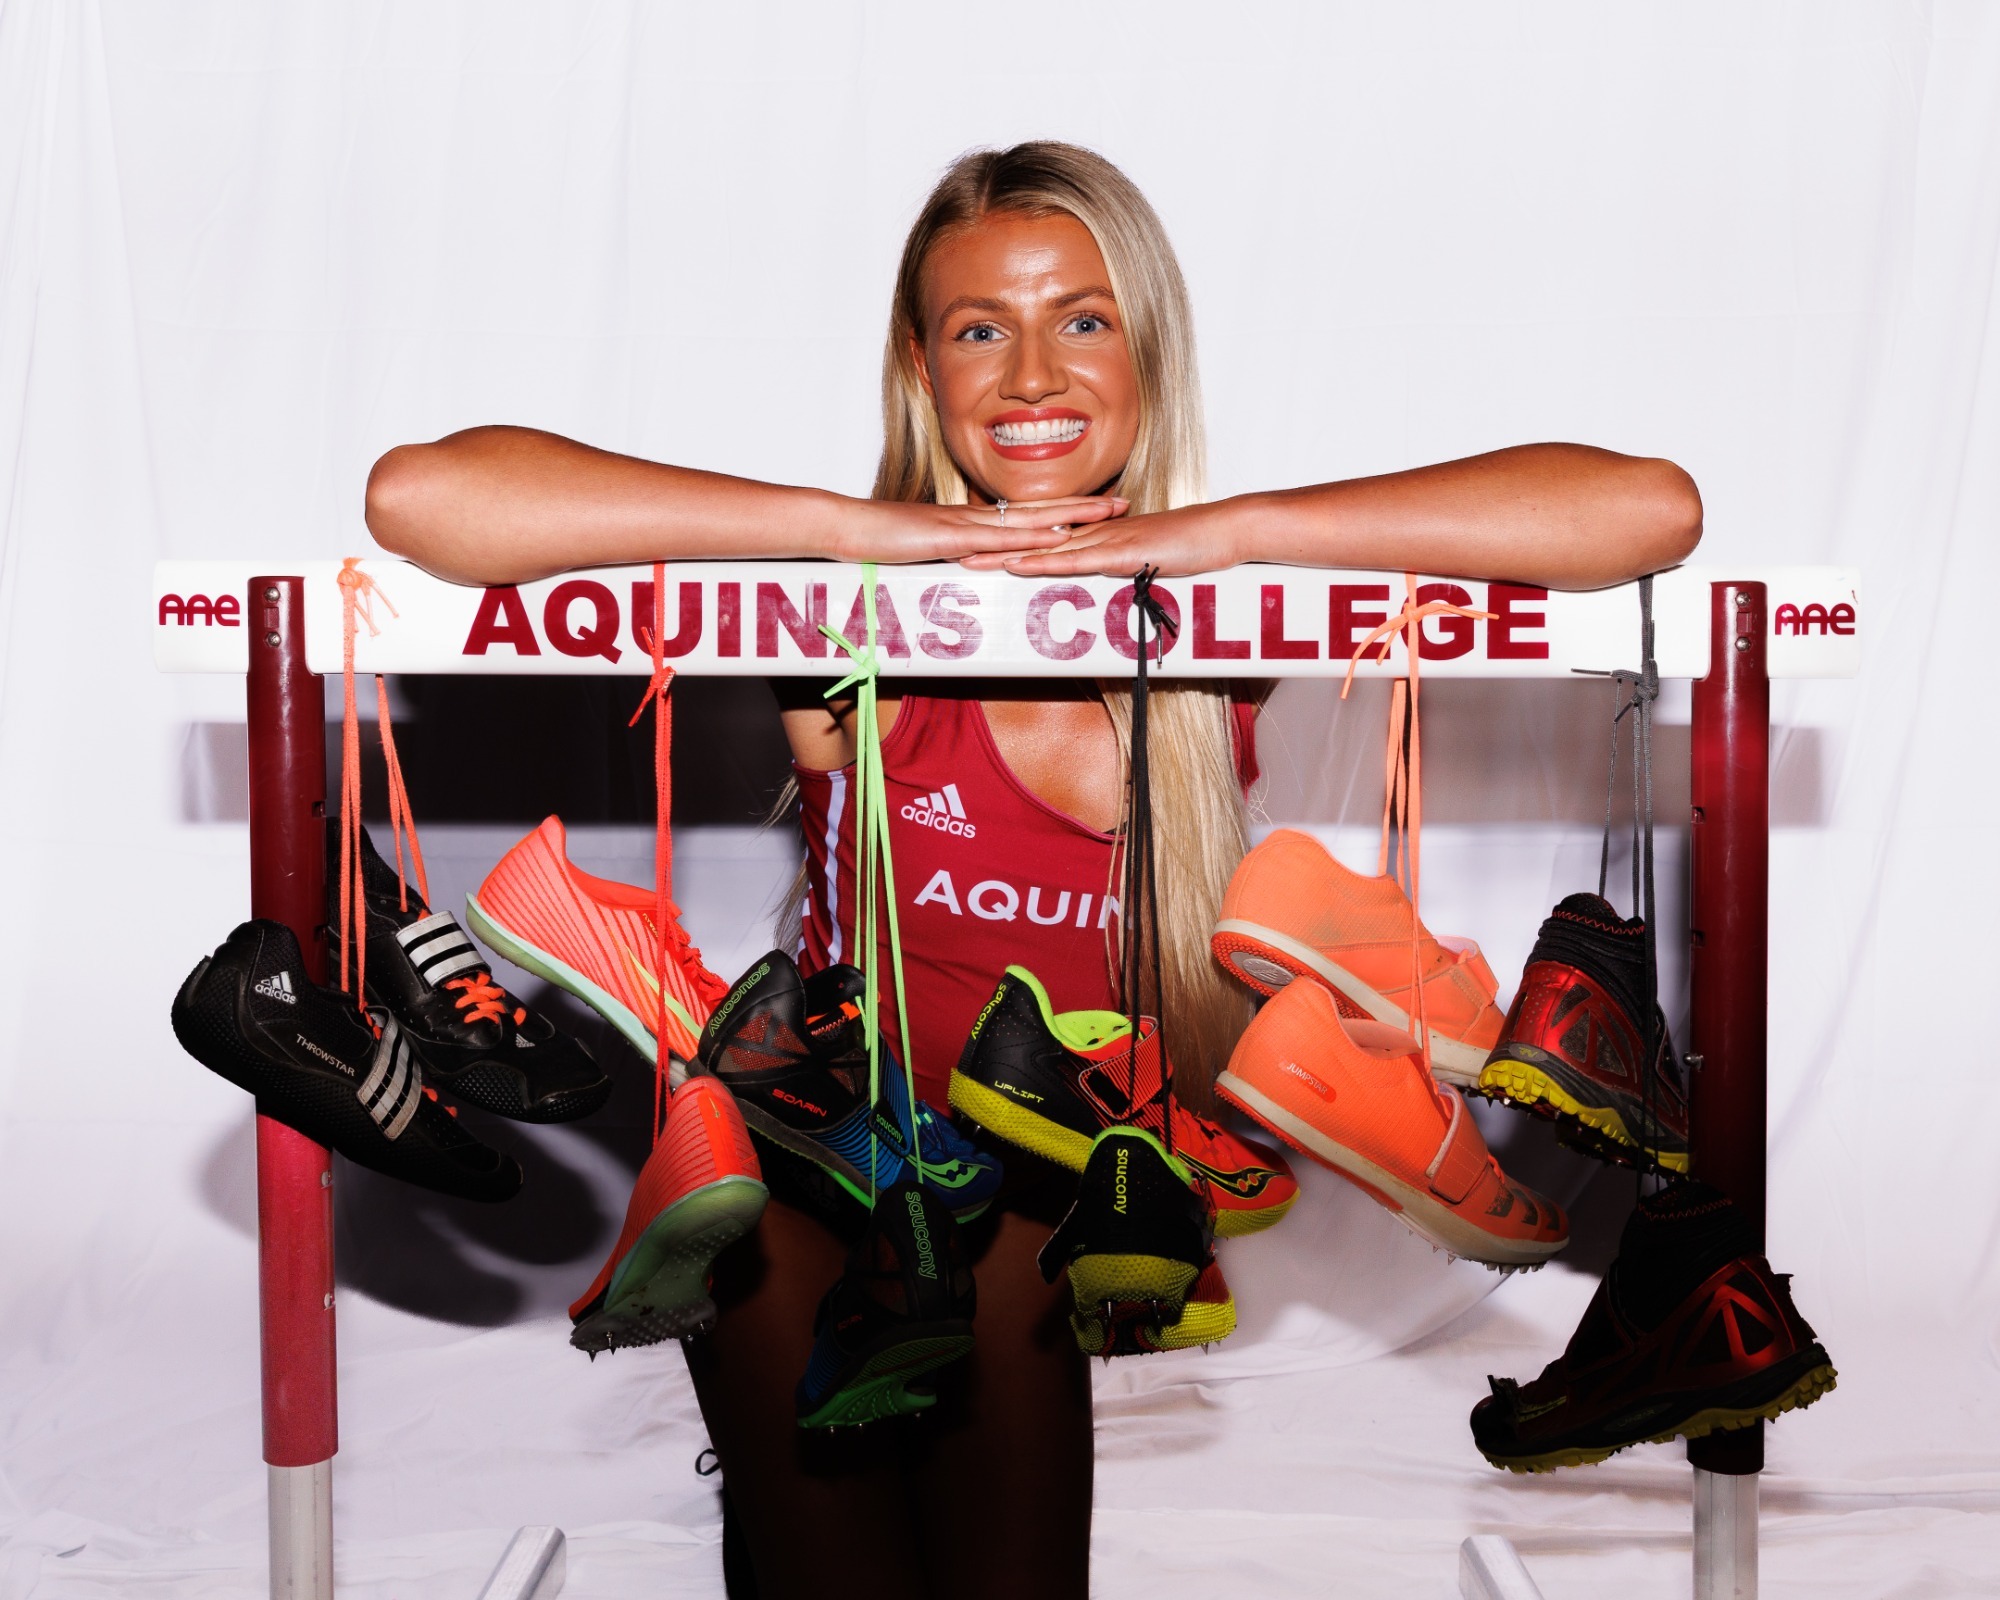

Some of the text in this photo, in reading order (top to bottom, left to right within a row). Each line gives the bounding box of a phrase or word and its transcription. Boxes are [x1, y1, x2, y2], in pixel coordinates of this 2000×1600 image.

[462, 580, 1549, 664] AQUINAS COLLEGE
[901, 804, 976, 838] adidas
[254, 984, 297, 1004] adidas
[709, 962, 770, 1037] saucony
[971, 983, 1007, 1040] saucony
[296, 1033, 355, 1077] THROWSTAR
[994, 1080, 1044, 1103] UPLIFT
[1286, 1062, 1328, 1095] JUMPSTAR
[772, 1088, 827, 1117] SOARIN
[875, 1113, 903, 1143] saucony
[1113, 1148, 1128, 1214] saucony
[905, 1191, 938, 1280] saucony
